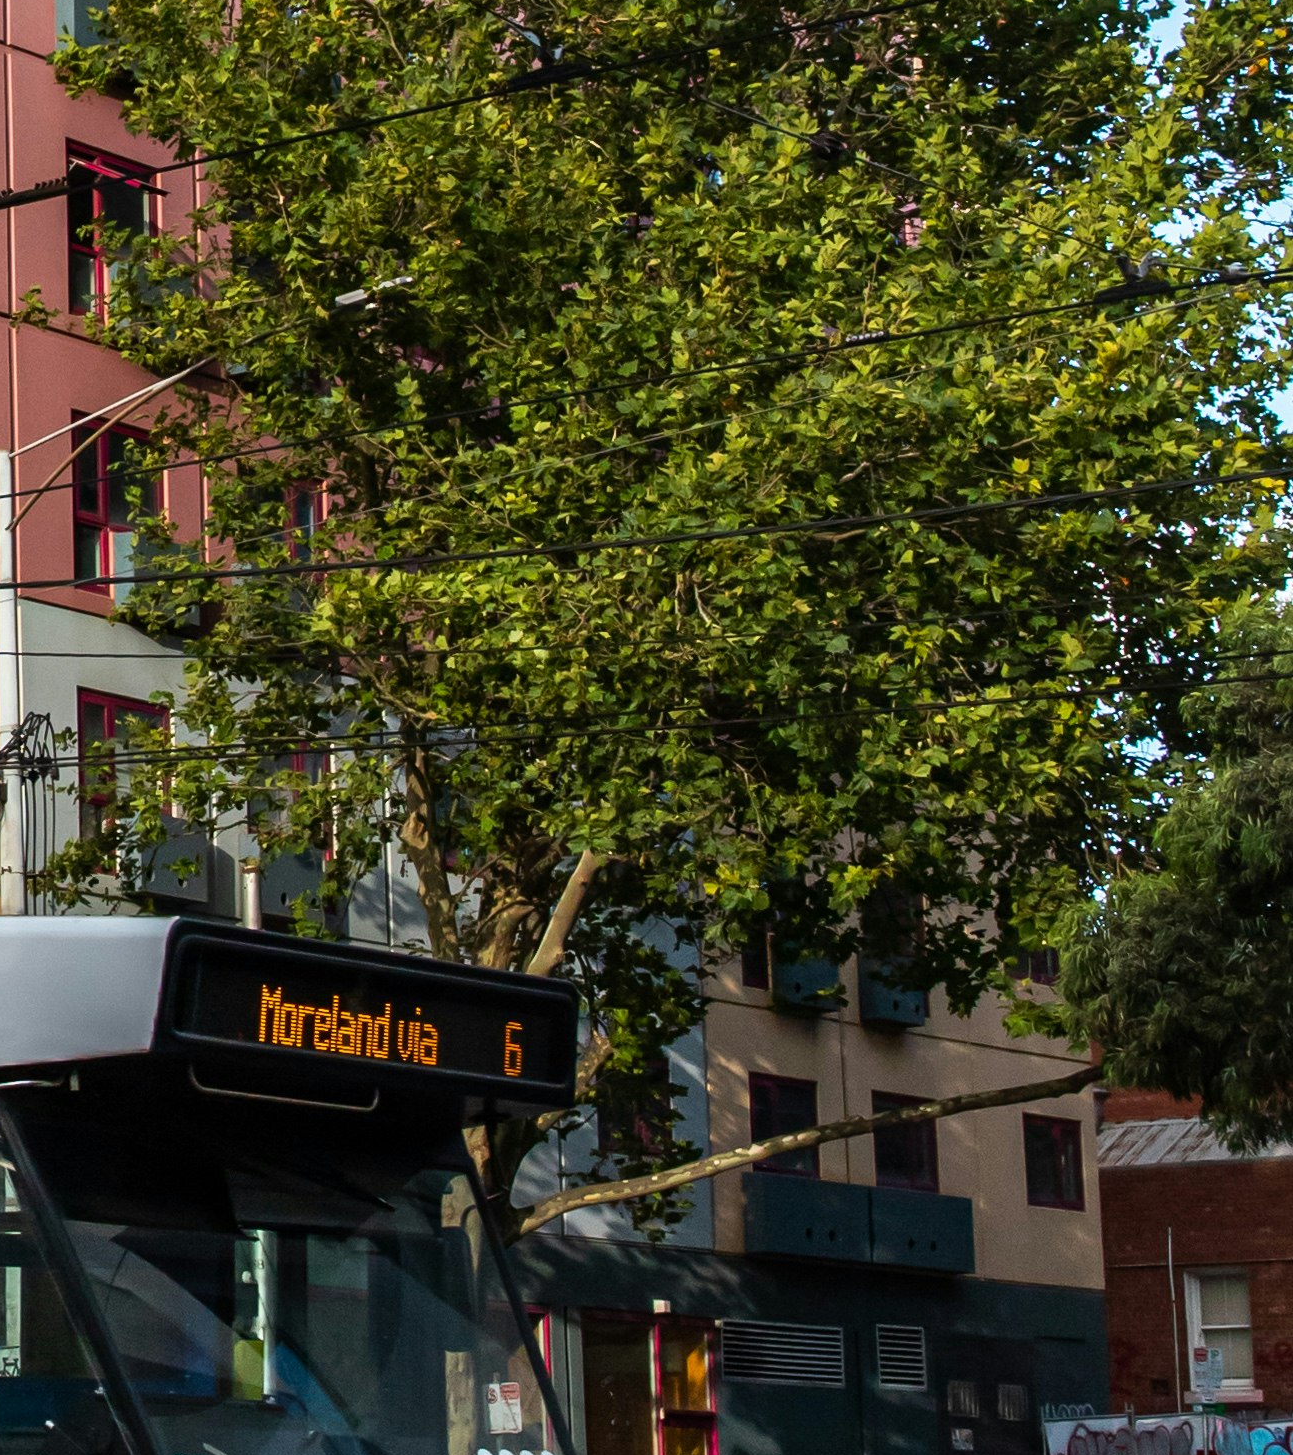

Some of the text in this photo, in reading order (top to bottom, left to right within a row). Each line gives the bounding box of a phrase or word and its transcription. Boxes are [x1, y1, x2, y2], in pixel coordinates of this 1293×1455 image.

[259, 984, 438, 1066] Moreland via
[503, 1021, 523, 1077] 6
